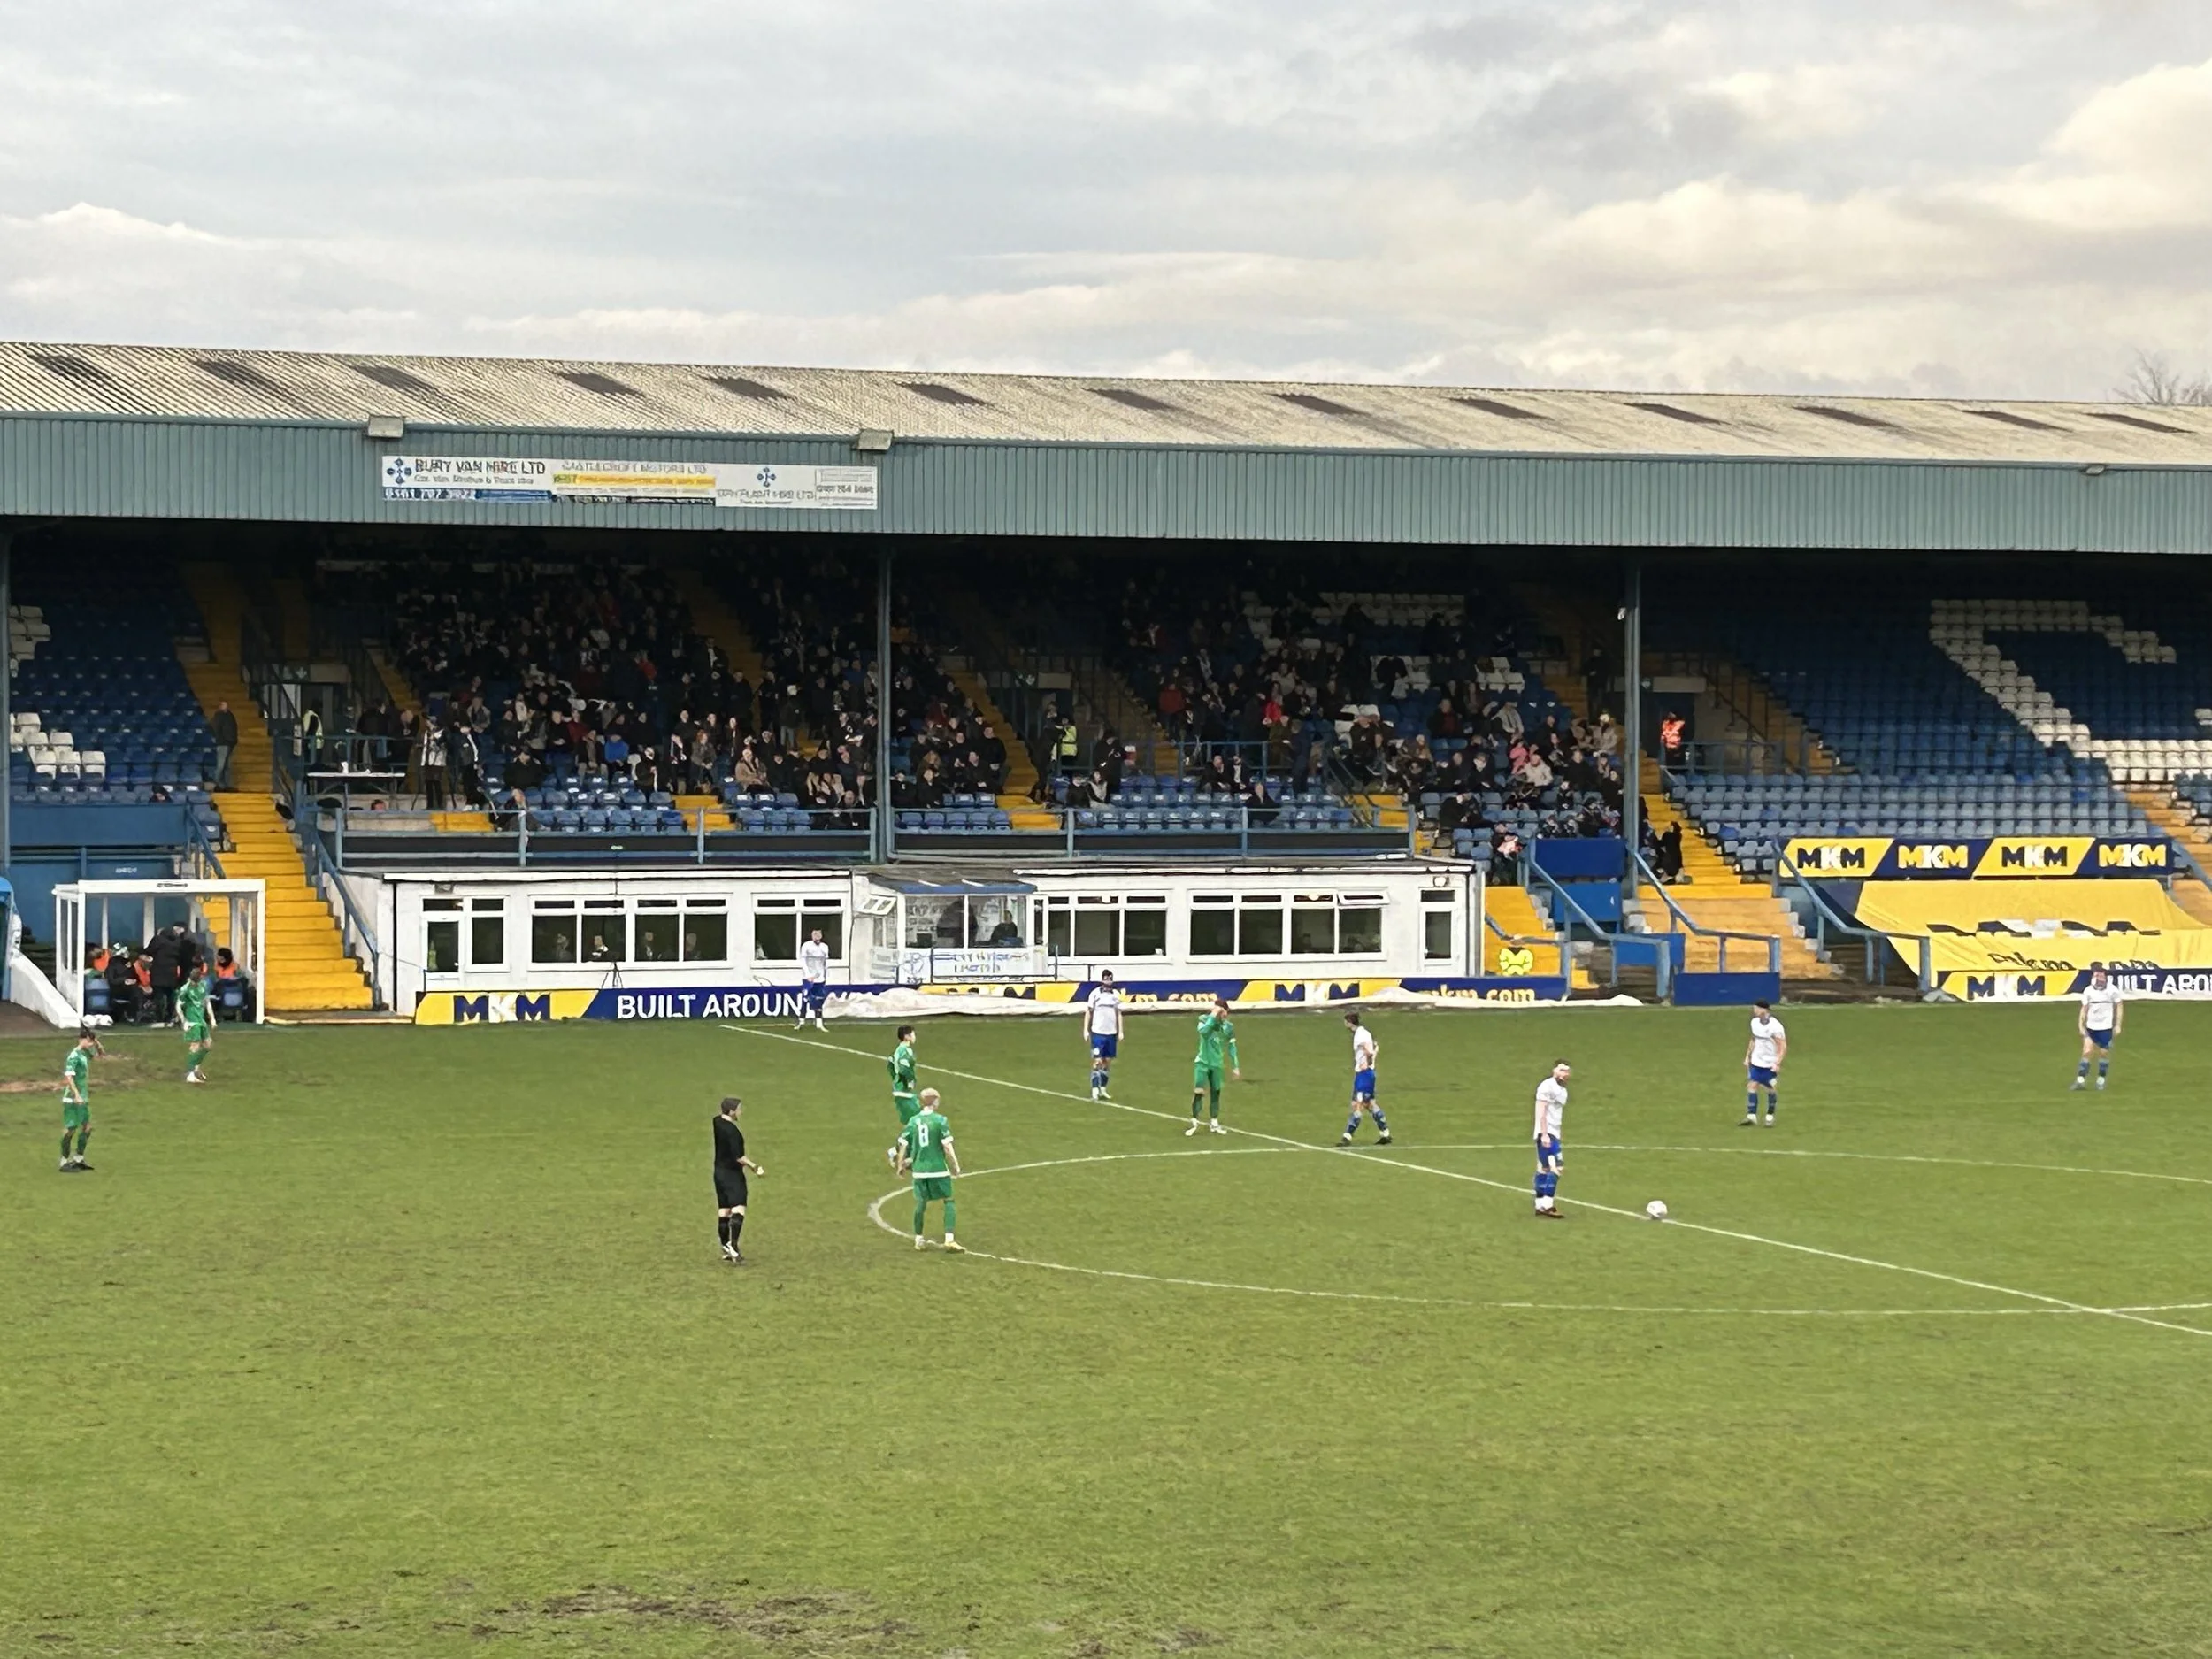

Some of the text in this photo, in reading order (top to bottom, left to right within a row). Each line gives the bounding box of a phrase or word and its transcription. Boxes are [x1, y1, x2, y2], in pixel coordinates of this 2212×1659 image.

[521, 461, 545, 474] LTD
[1797, 846, 1865, 870] MKM
[1898, 845, 1968, 869] MKM
[2001, 844, 2068, 869] MKM
[2098, 843, 2167, 868] MKM
[1274, 980, 1360, 1002] MKM
[1967, 974, 2046, 1001] MKM
[2108, 973, 2212, 993] UILT ARO
[454, 993, 550, 1023] MKM
[618, 994, 696, 1019] BUILT
[703, 992, 803, 1018] AROUN
[918, 1123, 929, 1148] 8
